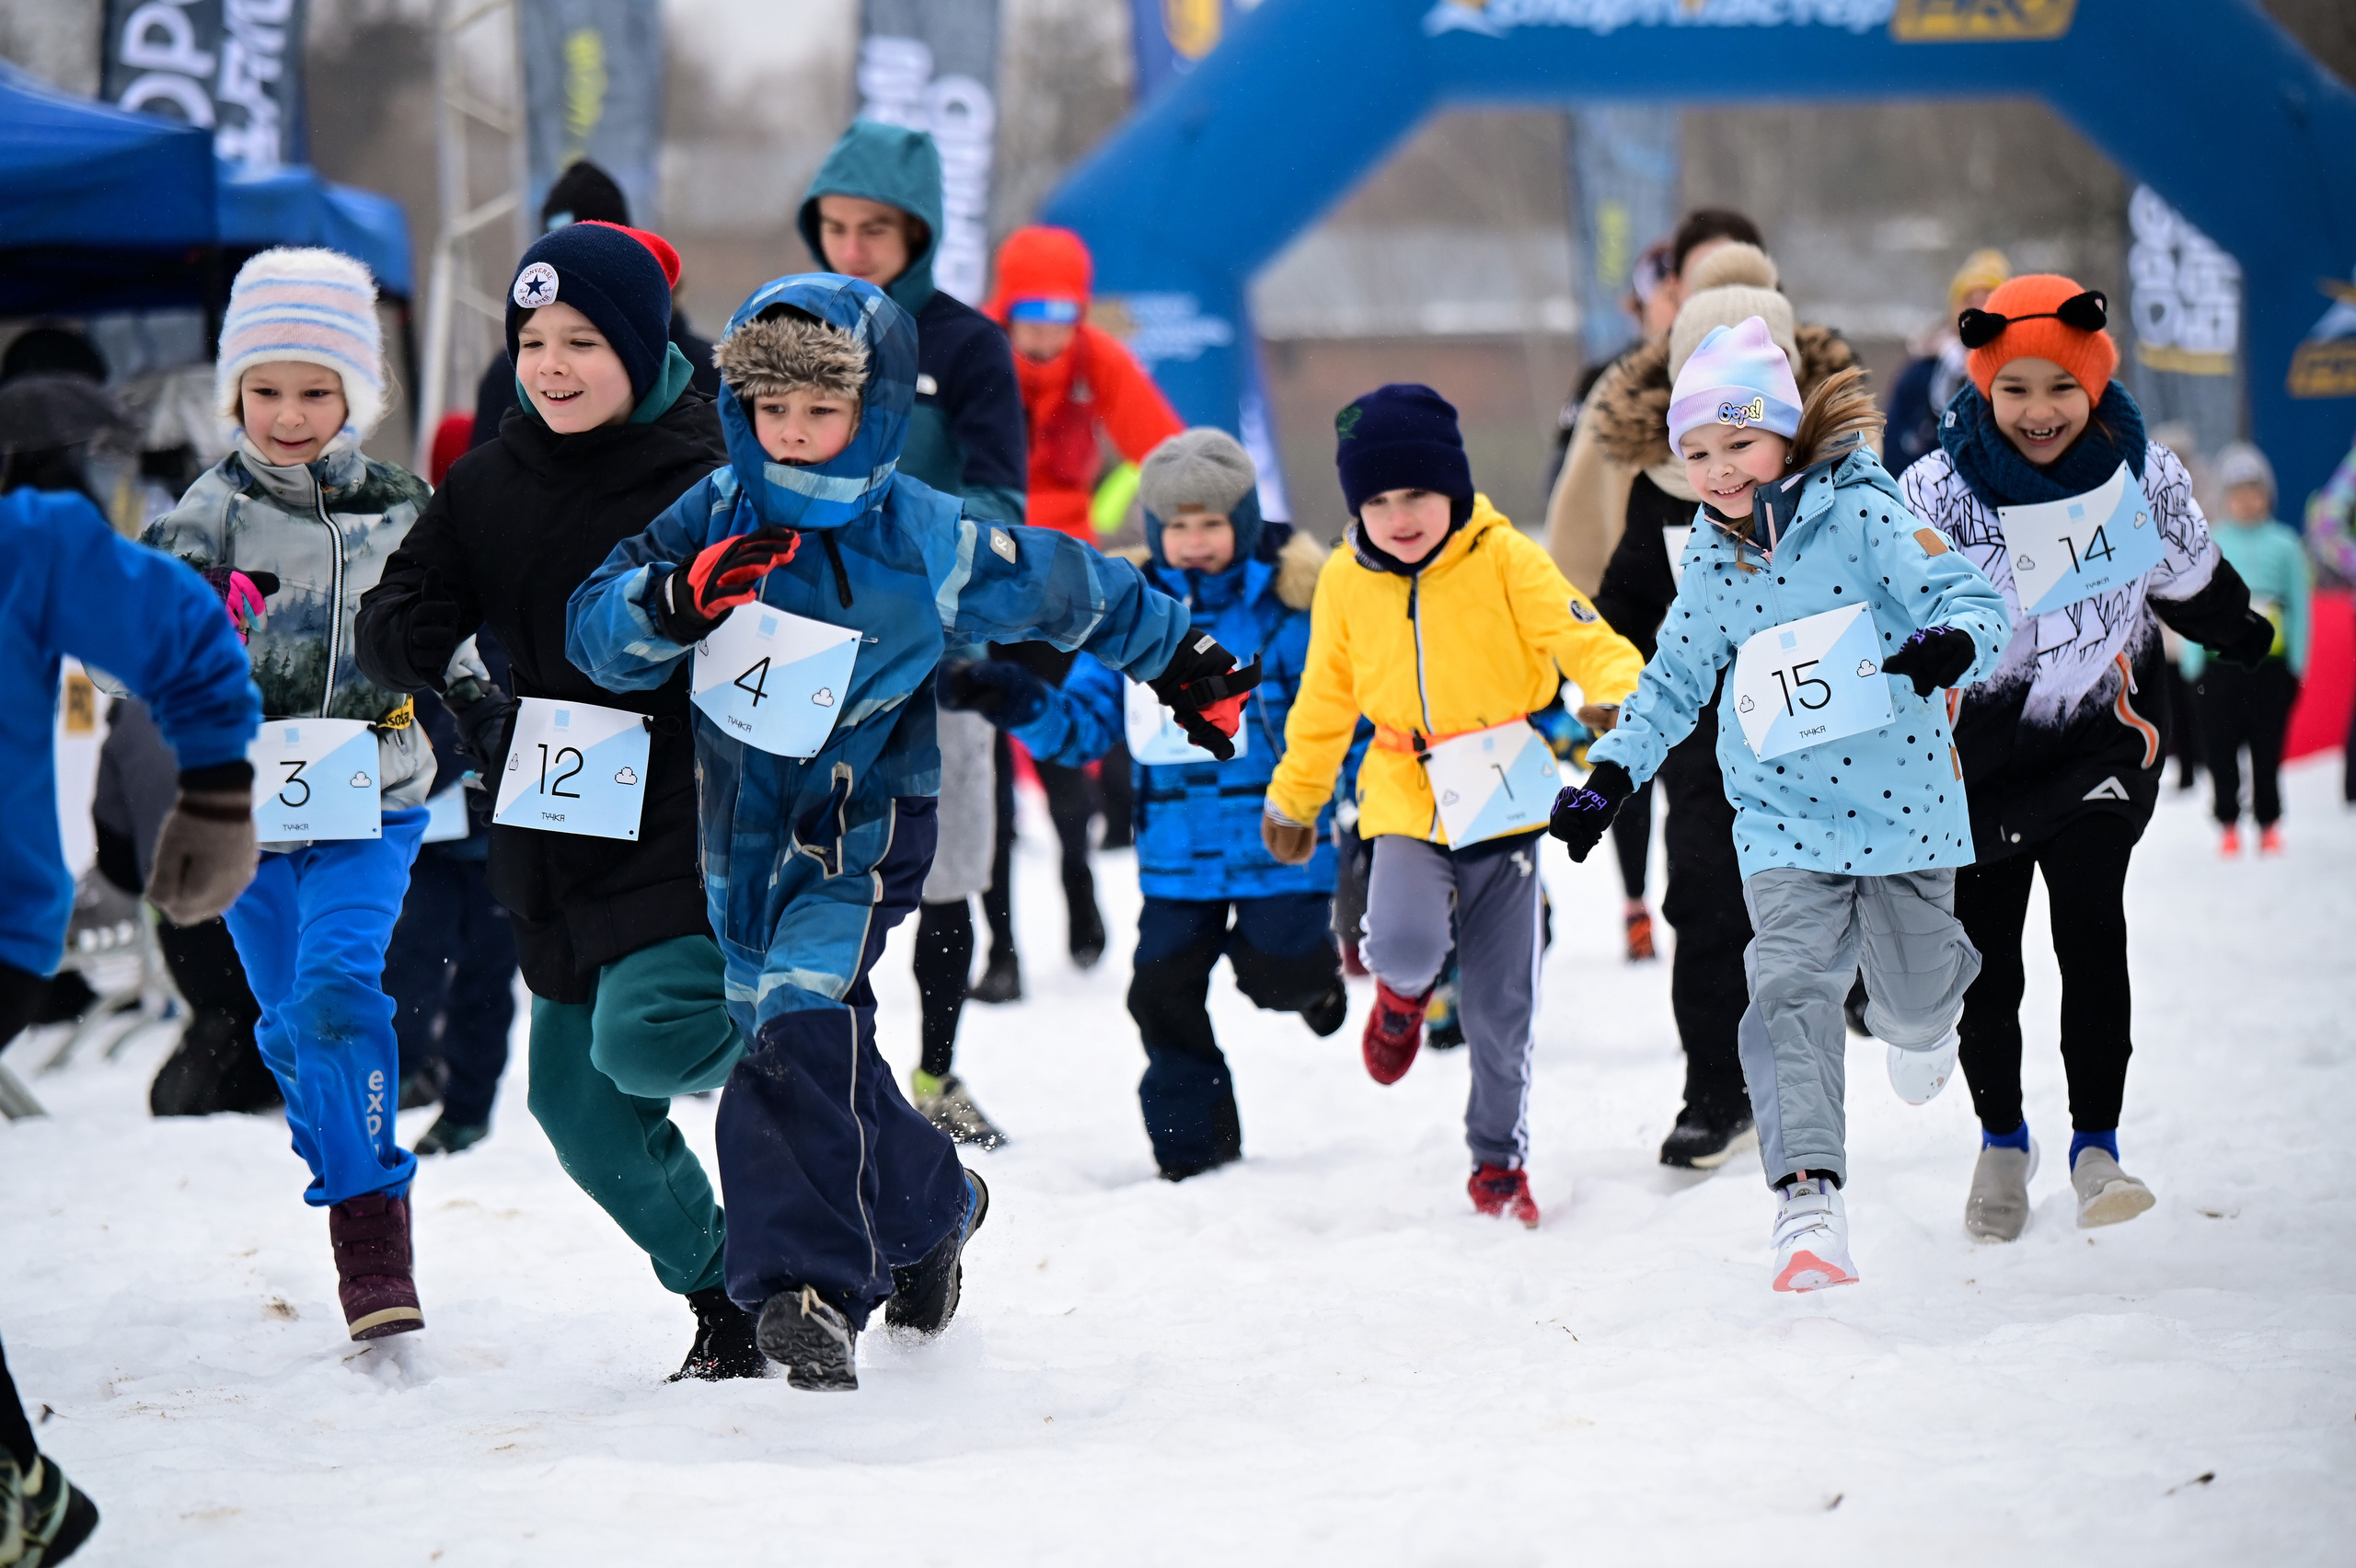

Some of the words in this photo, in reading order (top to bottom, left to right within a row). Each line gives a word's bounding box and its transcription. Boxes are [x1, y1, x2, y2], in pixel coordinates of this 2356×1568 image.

[521, 267, 554, 282] CONVERSE
[520, 295, 534, 305] ALL
[1718, 398, 1761, 426] Oops!
[2058, 525, 2116, 574] 14
[733, 656, 771, 708] 4
[1771, 659, 1831, 718] 15
[1798, 725, 1827, 739] ТУЧКА
[279, 760, 311, 808] 3
[537, 743, 584, 799] 12
[1490, 763, 1515, 801] 1
[366, 1069, 385, 1159] exp
